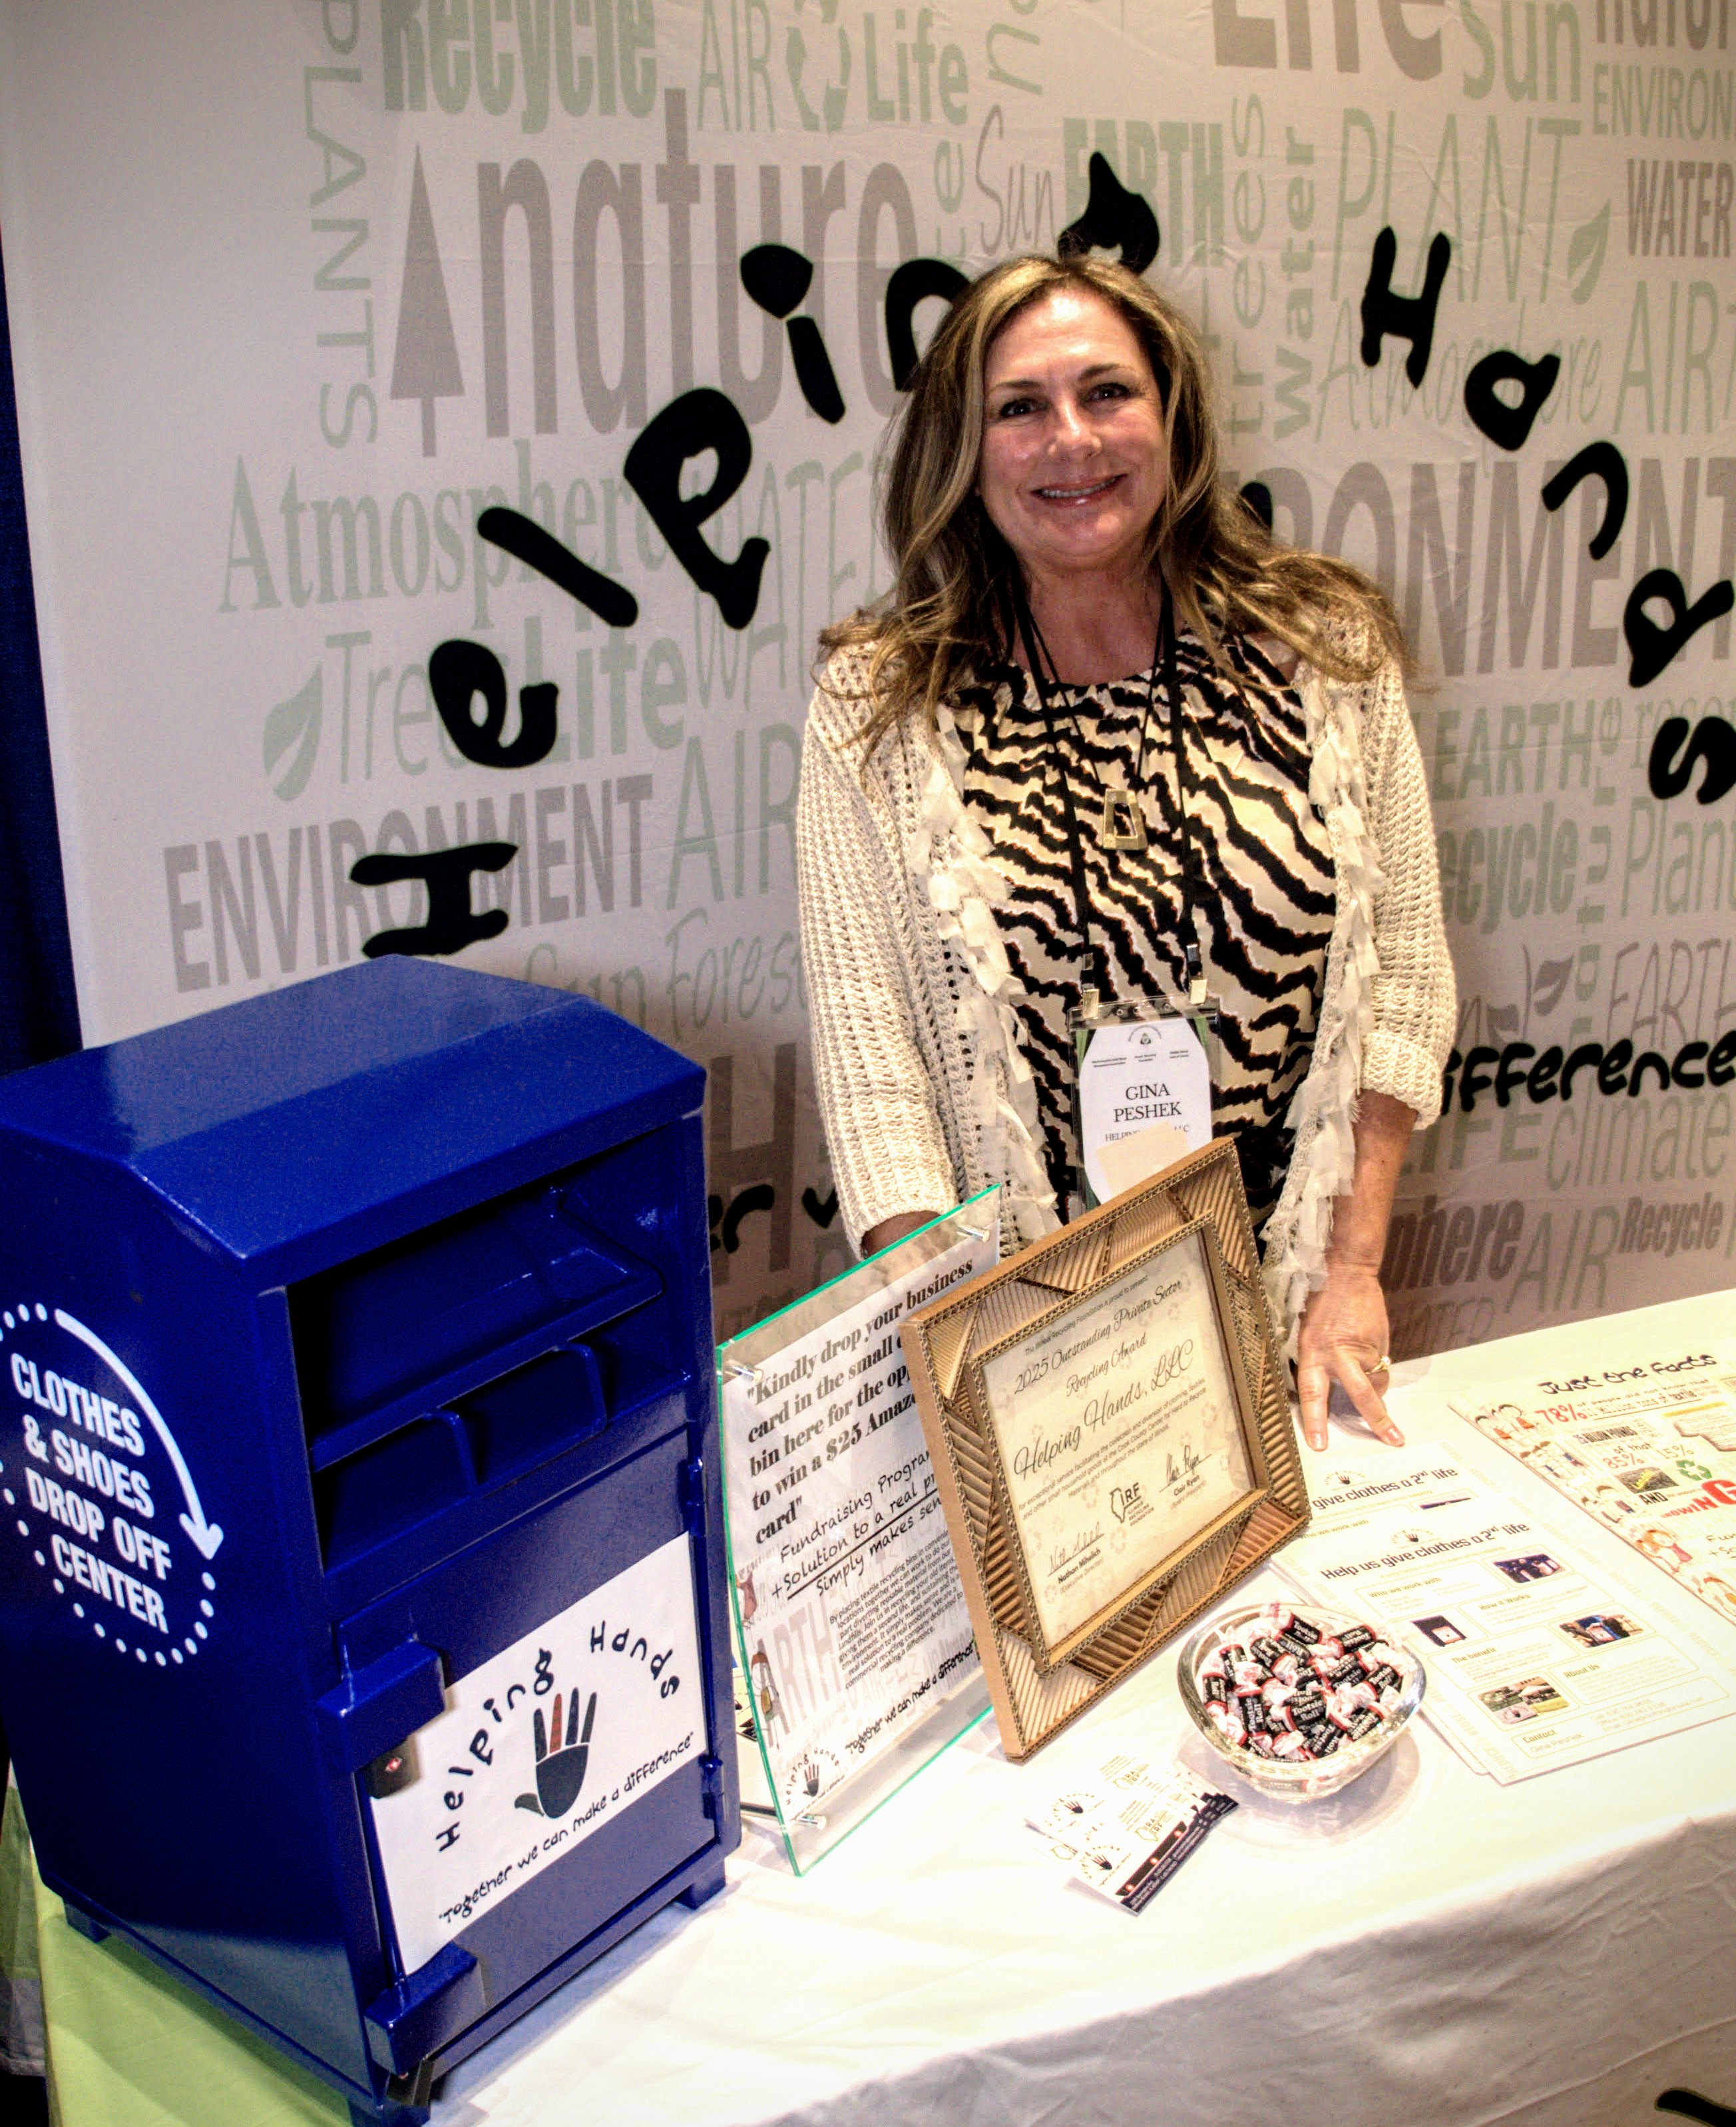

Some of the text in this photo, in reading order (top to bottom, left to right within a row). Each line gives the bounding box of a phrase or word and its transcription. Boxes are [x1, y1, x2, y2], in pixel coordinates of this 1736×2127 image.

[697, 0, 776, 132] AIR
[865, 8, 969, 125] Life
[977, 104, 1056, 256] Sun
[1627, 158, 1732, 258] WATER
[1612, 280, 1719, 434] AIR
[1113, 1101, 1182, 1123] PESHEK
[1125, 1082, 1171, 1100] GINA
[1618, 1192, 1725, 1258] Recycle
[747, 1260, 972, 1404] "Kindly drop your business
[1014, 1280, 1182, 1394] 2025 Outstanding Private Sector
[1066, 1331, 1146, 1397] Recycling Award
[10, 1352, 145, 1457] CLOTHES
[748, 1335, 893, 1443] card in the small
[1534, 1402, 1588, 1425] 78%
[1592, 1395, 1622, 1405] people
[1663, 1383, 1687, 1391] know
[1537, 1353, 1718, 1395] Just the Facts
[750, 1380, 882, 1476] bin here for the
[1013, 1339, 1193, 1479] Helping Hands, LLC
[23, 1414, 155, 1519] & SHOES
[752, 1422, 861, 1511] to win a $25
[1602, 1452, 1645, 1469] 85%
[1613, 1441, 1653, 1455] of that
[756, 1496, 801, 1544] card"
[853, 1522, 869, 1539] to
[875, 1512, 884, 1524] a
[890, 1482, 919, 1512] real
[1120, 1482, 1139, 1505] IRF
[1312, 1489, 1345, 1509] give
[1345, 1480, 1401, 1502] clothes
[1403, 1478, 1412, 1488] a
[1434, 1467, 1458, 1479] life
[1638, 1491, 1669, 1505] AND
[25, 1467, 172, 1580] DROP OFF
[780, 1492, 873, 1562] Fundraising
[816, 1554, 864, 1596] Simply
[869, 1515, 915, 1558] makes
[1320, 1562, 1359, 1580] Help
[1359, 1558, 1381, 1570] us
[1381, 1552, 1415, 1567] give
[1414, 1538, 1472, 1558] clothes
[1471, 1535, 1484, 1543] a
[1501, 1521, 1530, 1536] life
[51, 1533, 169, 1634] CENTER
[829, 1614, 837, 1624] By
[838, 1597, 860, 1619] placing
[860, 1582, 879, 1600] textile
[879, 1562, 905, 1585] recycling
[905, 1553, 918, 1566] bins
[1057, 1565, 1078, 1584] Nathan
[1369, 1589, 1387, 1598] Who
[1401, 1581, 1422, 1592] work
[1423, 1576, 1442, 1586] with
[1478, 1593, 1530, 1611] How Works
[1451, 1647, 1496, 1663] The benefit
[1563, 1666, 1589, 1678] About
[884, 1706, 897, 1723] we
[897, 1698, 911, 1713] can
[911, 1677, 931, 1702] make
[931, 1674, 937, 1684] a
[1292, 1700, 1323, 1716] Tootsie
[1300, 1707, 1320, 1721] Roll
[435, 1620, 681, 1853] Helping Hands
[1522, 1729, 1557, 1744] Contact
[517, 1844, 539, 1869] we
[542, 1828, 568, 1851] can
[572, 1796, 608, 1832] make
[611, 1788, 620, 1801] a
